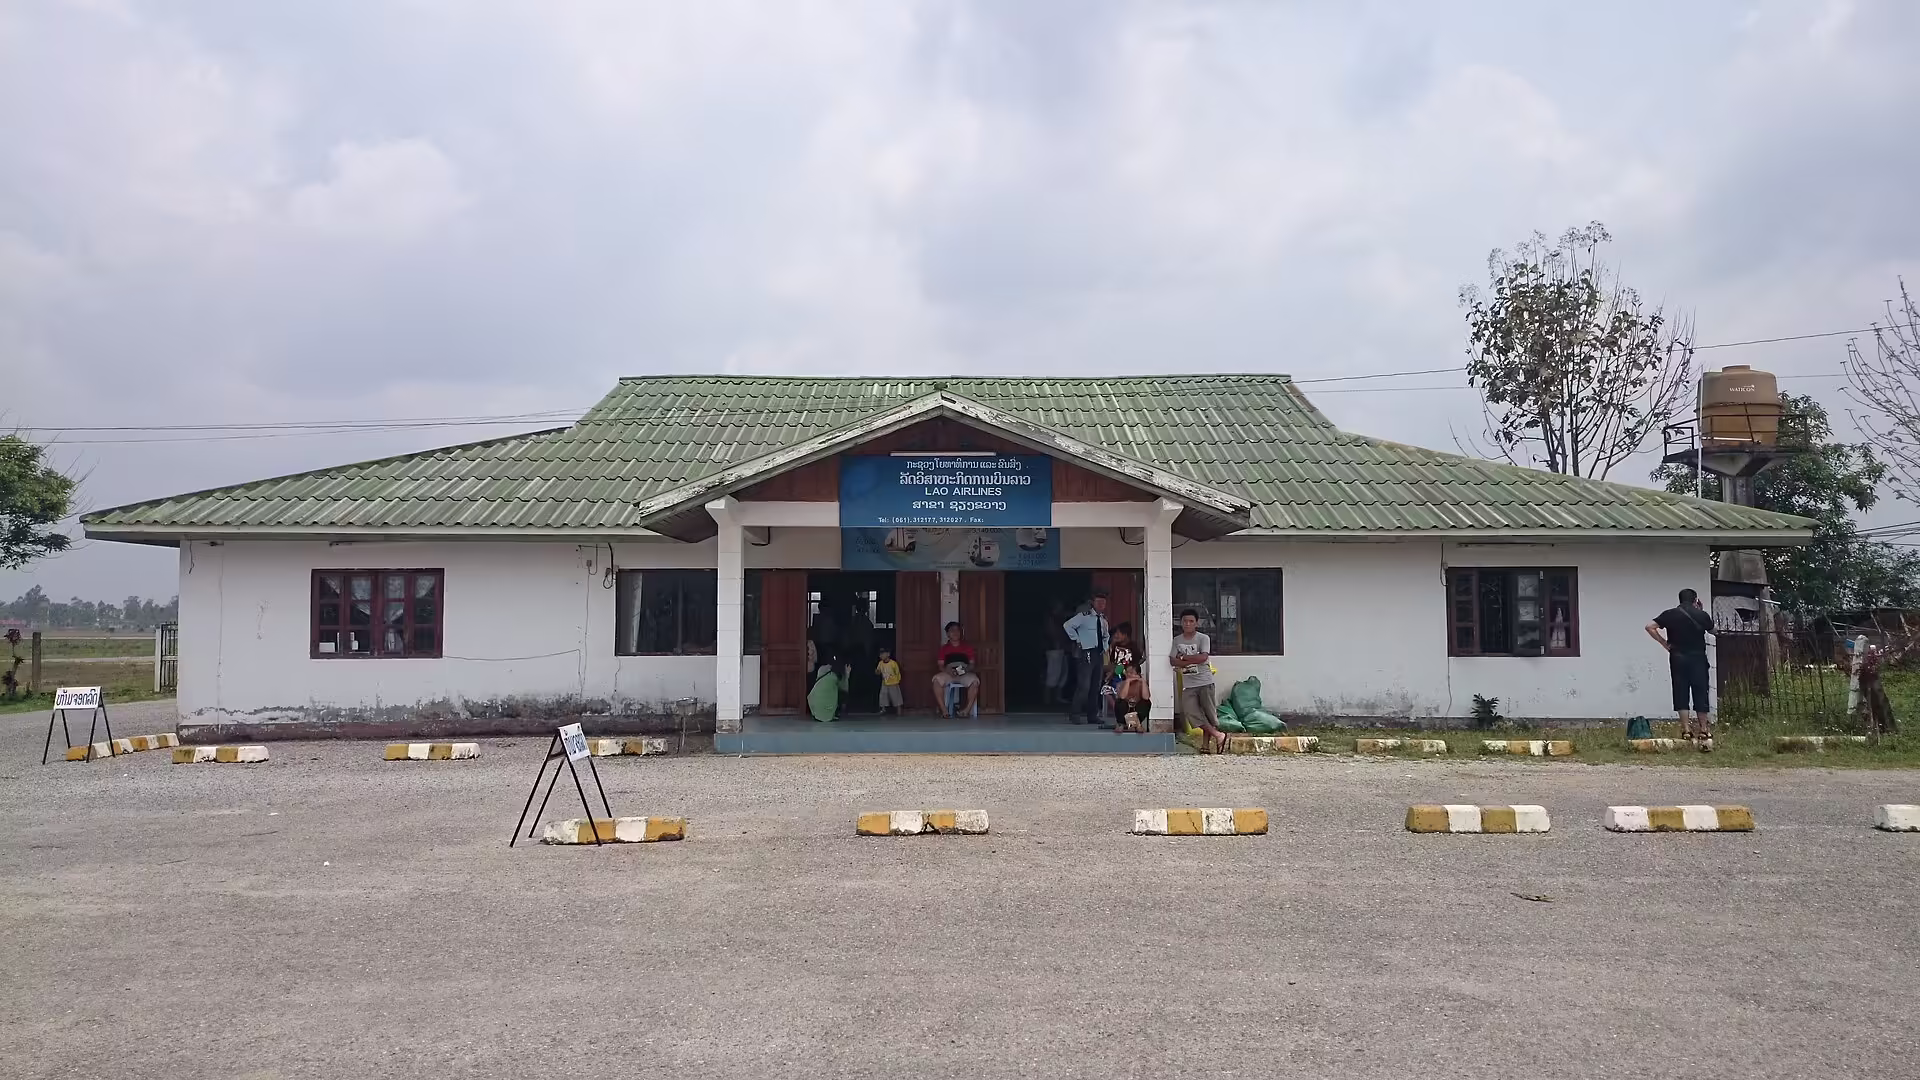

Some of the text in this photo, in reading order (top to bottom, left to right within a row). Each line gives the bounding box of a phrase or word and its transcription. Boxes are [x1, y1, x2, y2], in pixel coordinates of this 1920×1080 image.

[925, 487, 1002, 496] LAO AIRLINES
[912, 500, 1007, 512] ສາຂາ ຊຽງຂວາງ
